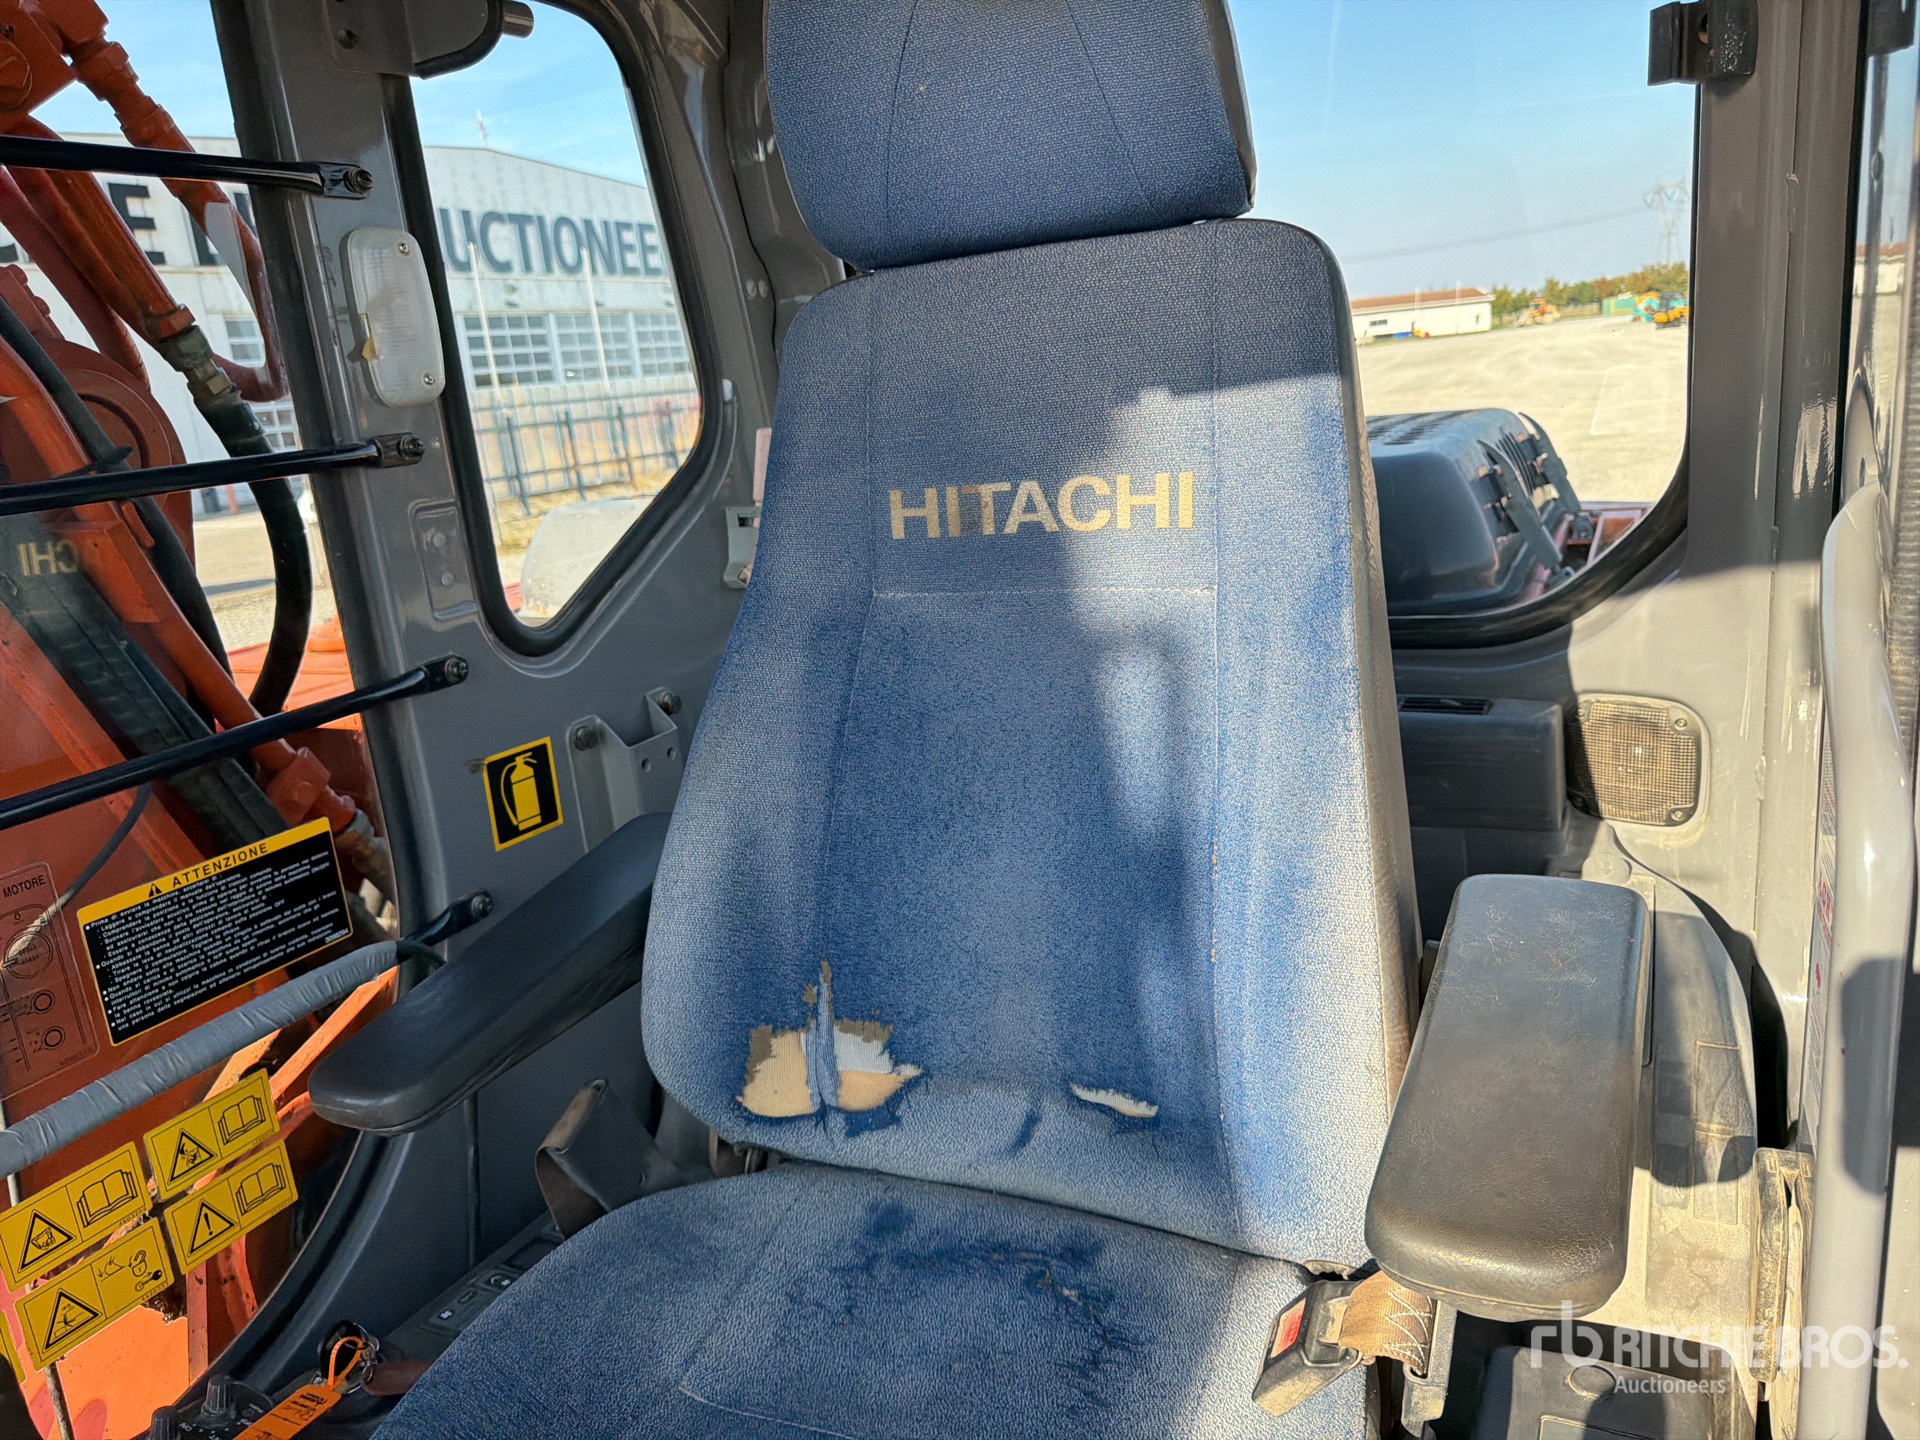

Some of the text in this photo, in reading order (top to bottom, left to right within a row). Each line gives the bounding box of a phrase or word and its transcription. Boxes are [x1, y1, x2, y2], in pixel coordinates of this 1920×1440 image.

[888, 471, 1194, 540] HITACHI
[2, 874, 46, 898] MOTORE
[172, 842, 268, 888] ATTENZIONE
